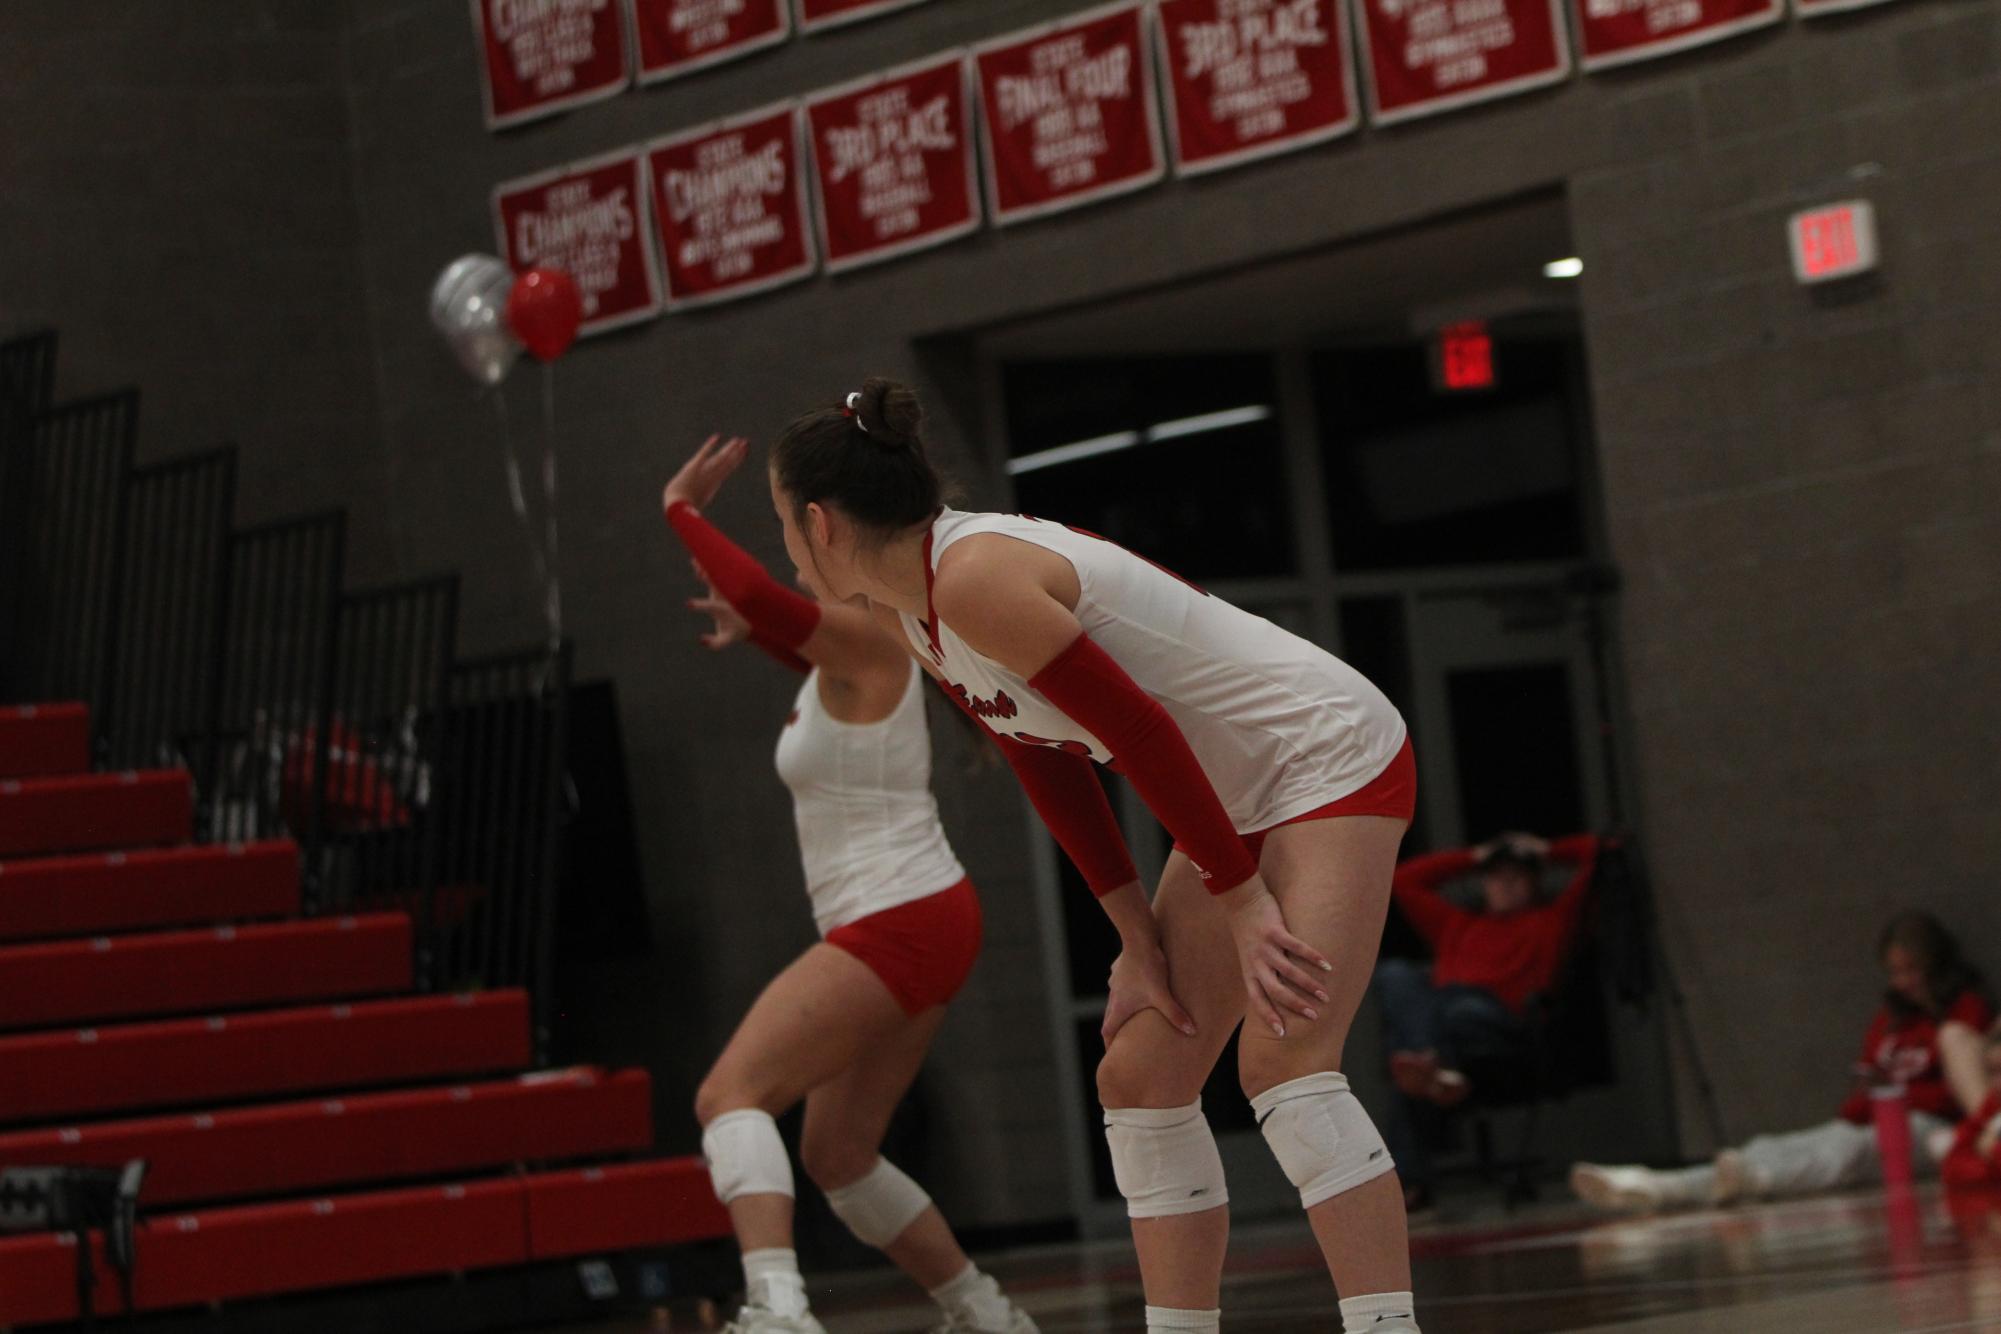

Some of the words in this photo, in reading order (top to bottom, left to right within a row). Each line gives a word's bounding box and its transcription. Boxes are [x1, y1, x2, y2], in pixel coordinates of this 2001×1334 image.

[996, 71, 1064, 129] FINAL
[1066, 44, 1129, 103] FOUR
[664, 138, 784, 222] CHAMPIONS
[826, 123, 877, 182] 3RD
[878, 96, 955, 154] PLACE
[517, 187, 631, 262] CHAMPIONS
[1800, 206, 1857, 275] EXIT
